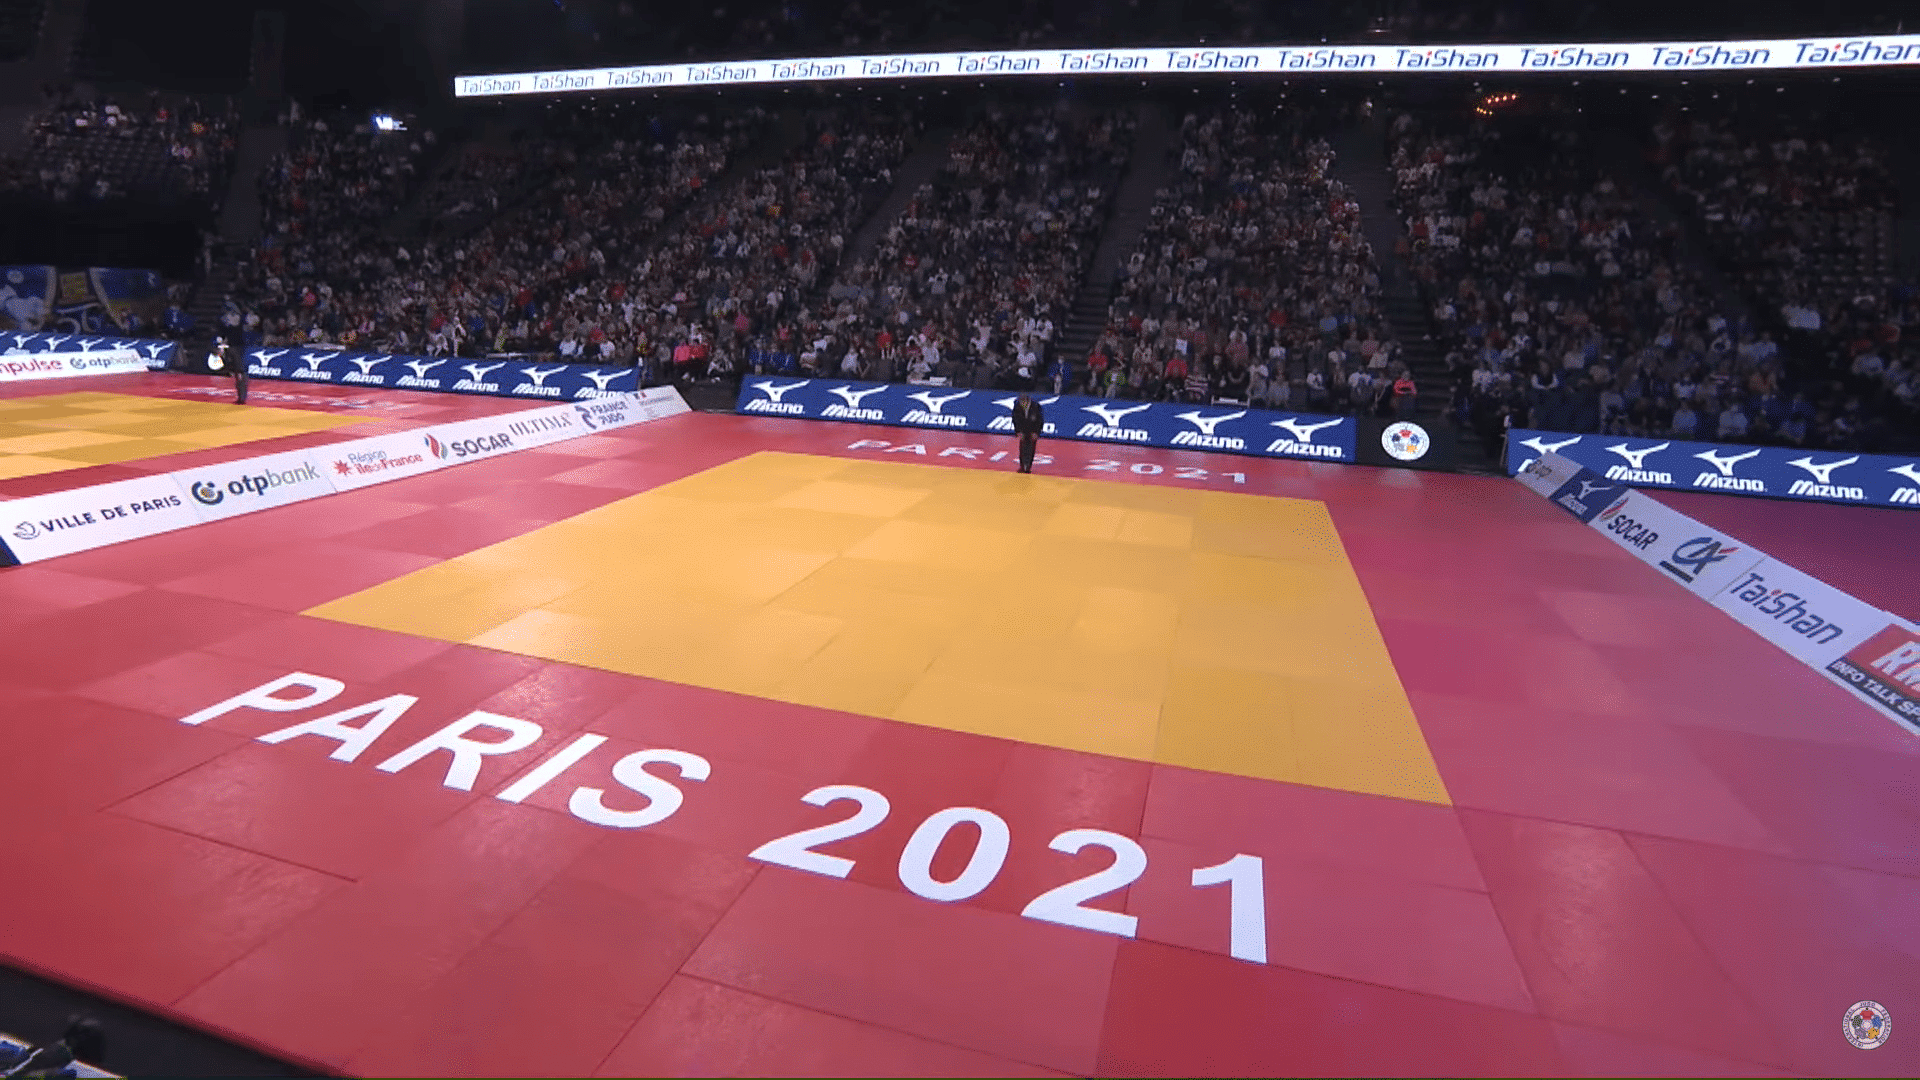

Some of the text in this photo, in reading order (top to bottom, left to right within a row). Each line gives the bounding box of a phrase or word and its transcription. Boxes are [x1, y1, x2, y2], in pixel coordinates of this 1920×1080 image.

[462, 79, 521, 93] TaiShan
[532, 75, 594, 89] TaiShan
[607, 70, 672, 85] TaiShan
[686, 65, 756, 82] TaiShan
[770, 62, 845, 78] TaiShan
[861, 58, 940, 75] TaiShan
[957, 55, 1040, 72] TaiShan
[1059, 53, 1148, 70] TaiShan
[1166, 51, 1259, 69] TaiShan
[1278, 49, 1375, 68] TaiShan
[1396, 48, 1498, 67] TaiShan
[1520, 47, 1629, 67] TaiShan
[1653, 45, 1770, 66] TaiShan
[451, 433, 514, 458] SOCAR
[1084, 459, 1246, 484] 2021
[40, 495, 182, 532] VILLE DE PARIS
[1607, 514, 1659, 550] SOCAR
[1729, 572, 1843, 645] TaiShan
[178, 671, 1268, 966] PARIS 2021
